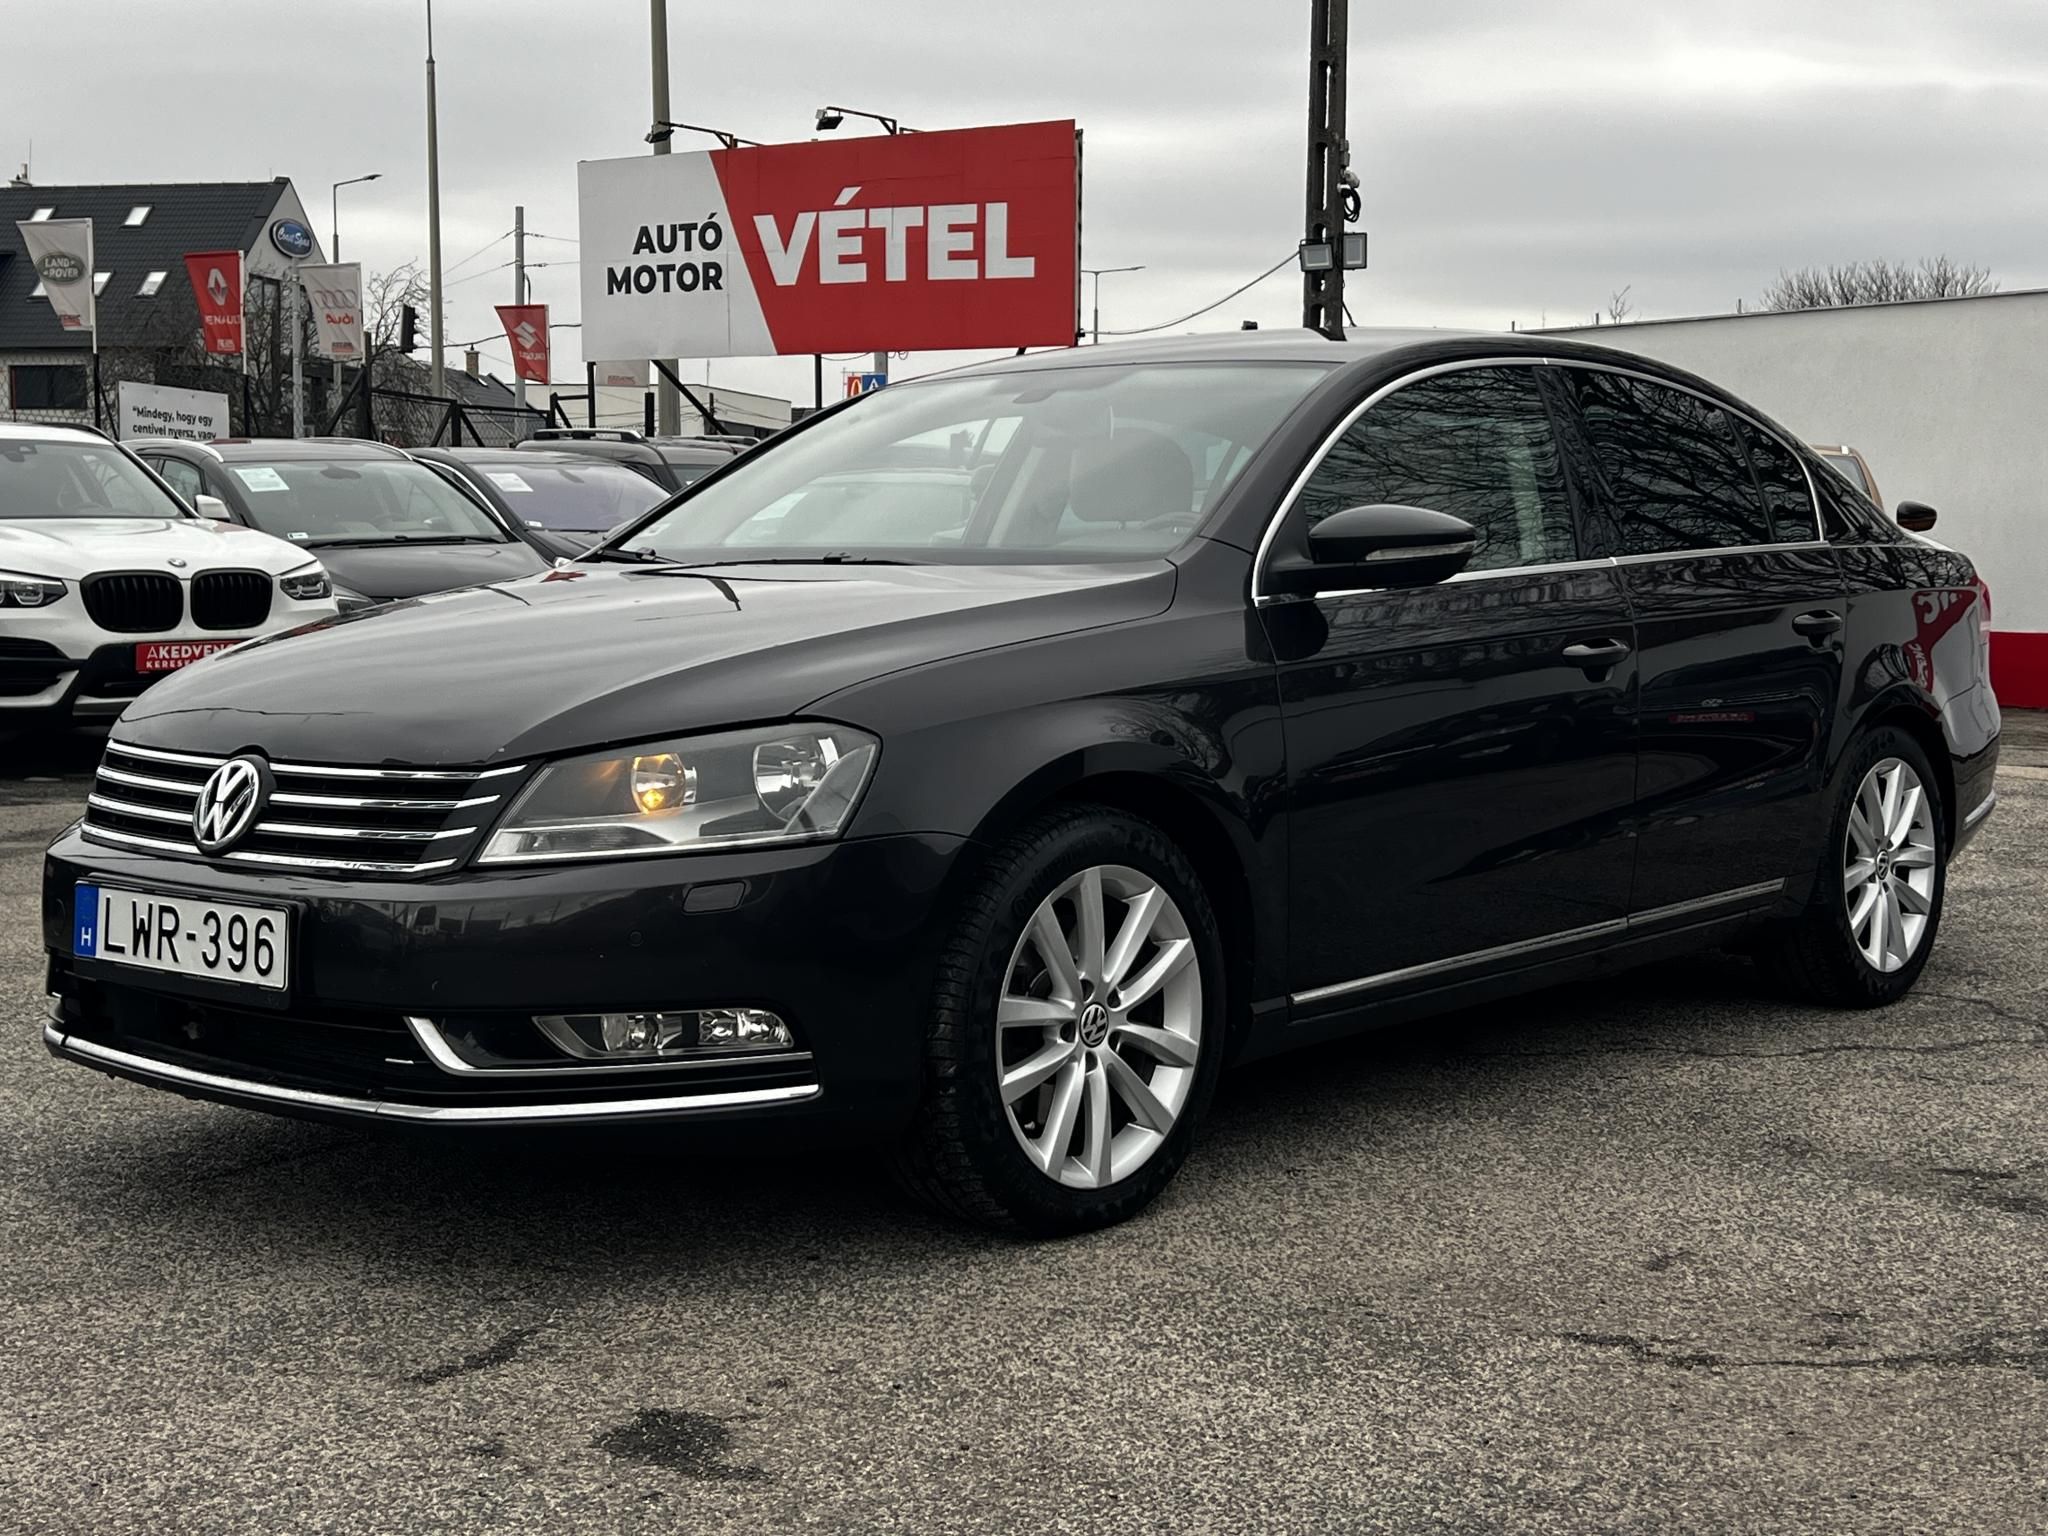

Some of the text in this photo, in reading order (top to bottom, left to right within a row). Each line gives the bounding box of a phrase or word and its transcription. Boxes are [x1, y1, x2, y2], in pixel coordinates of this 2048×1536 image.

[633, 212, 723, 255] AUTÓ
[752, 186, 1036, 287] VÉTEL
[606, 261, 723, 296] MOTOR
[176, 410, 196, 426] hogy
[197, 415, 213, 427] egy
[81, 926, 92, 947] H
[103, 896, 276, 977] LWR-396
